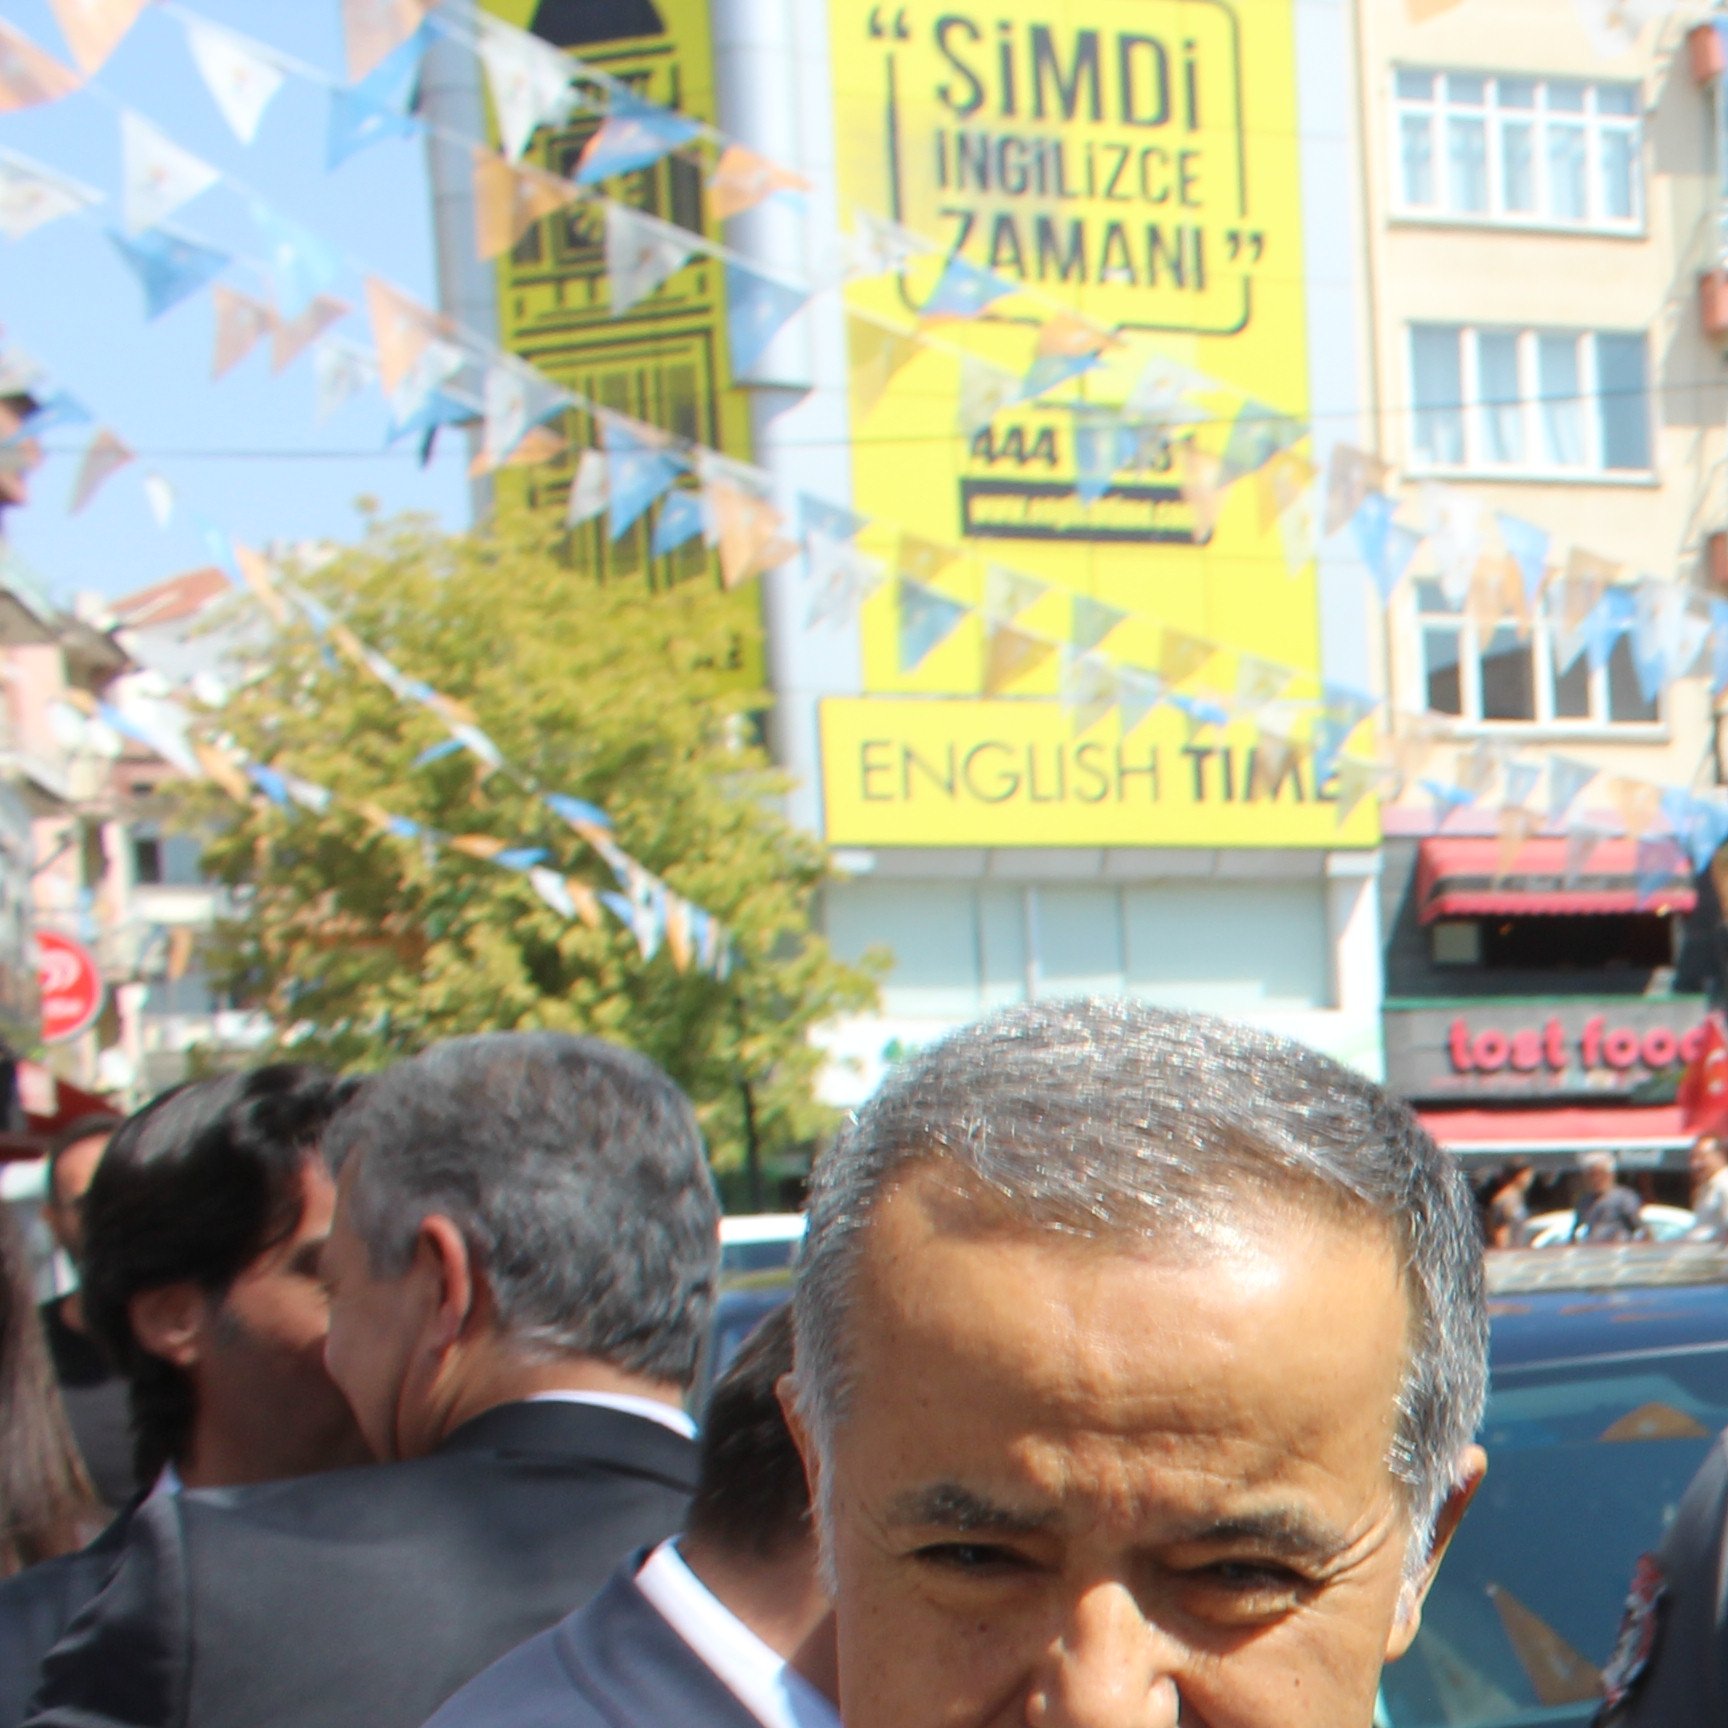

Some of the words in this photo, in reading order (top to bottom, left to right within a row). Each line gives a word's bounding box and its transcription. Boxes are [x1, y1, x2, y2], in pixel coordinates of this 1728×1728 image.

[971, 424, 1059, 467] 444
[859, 737, 1160, 803] ENGLISH
[1447, 1015, 1568, 1073] tost
